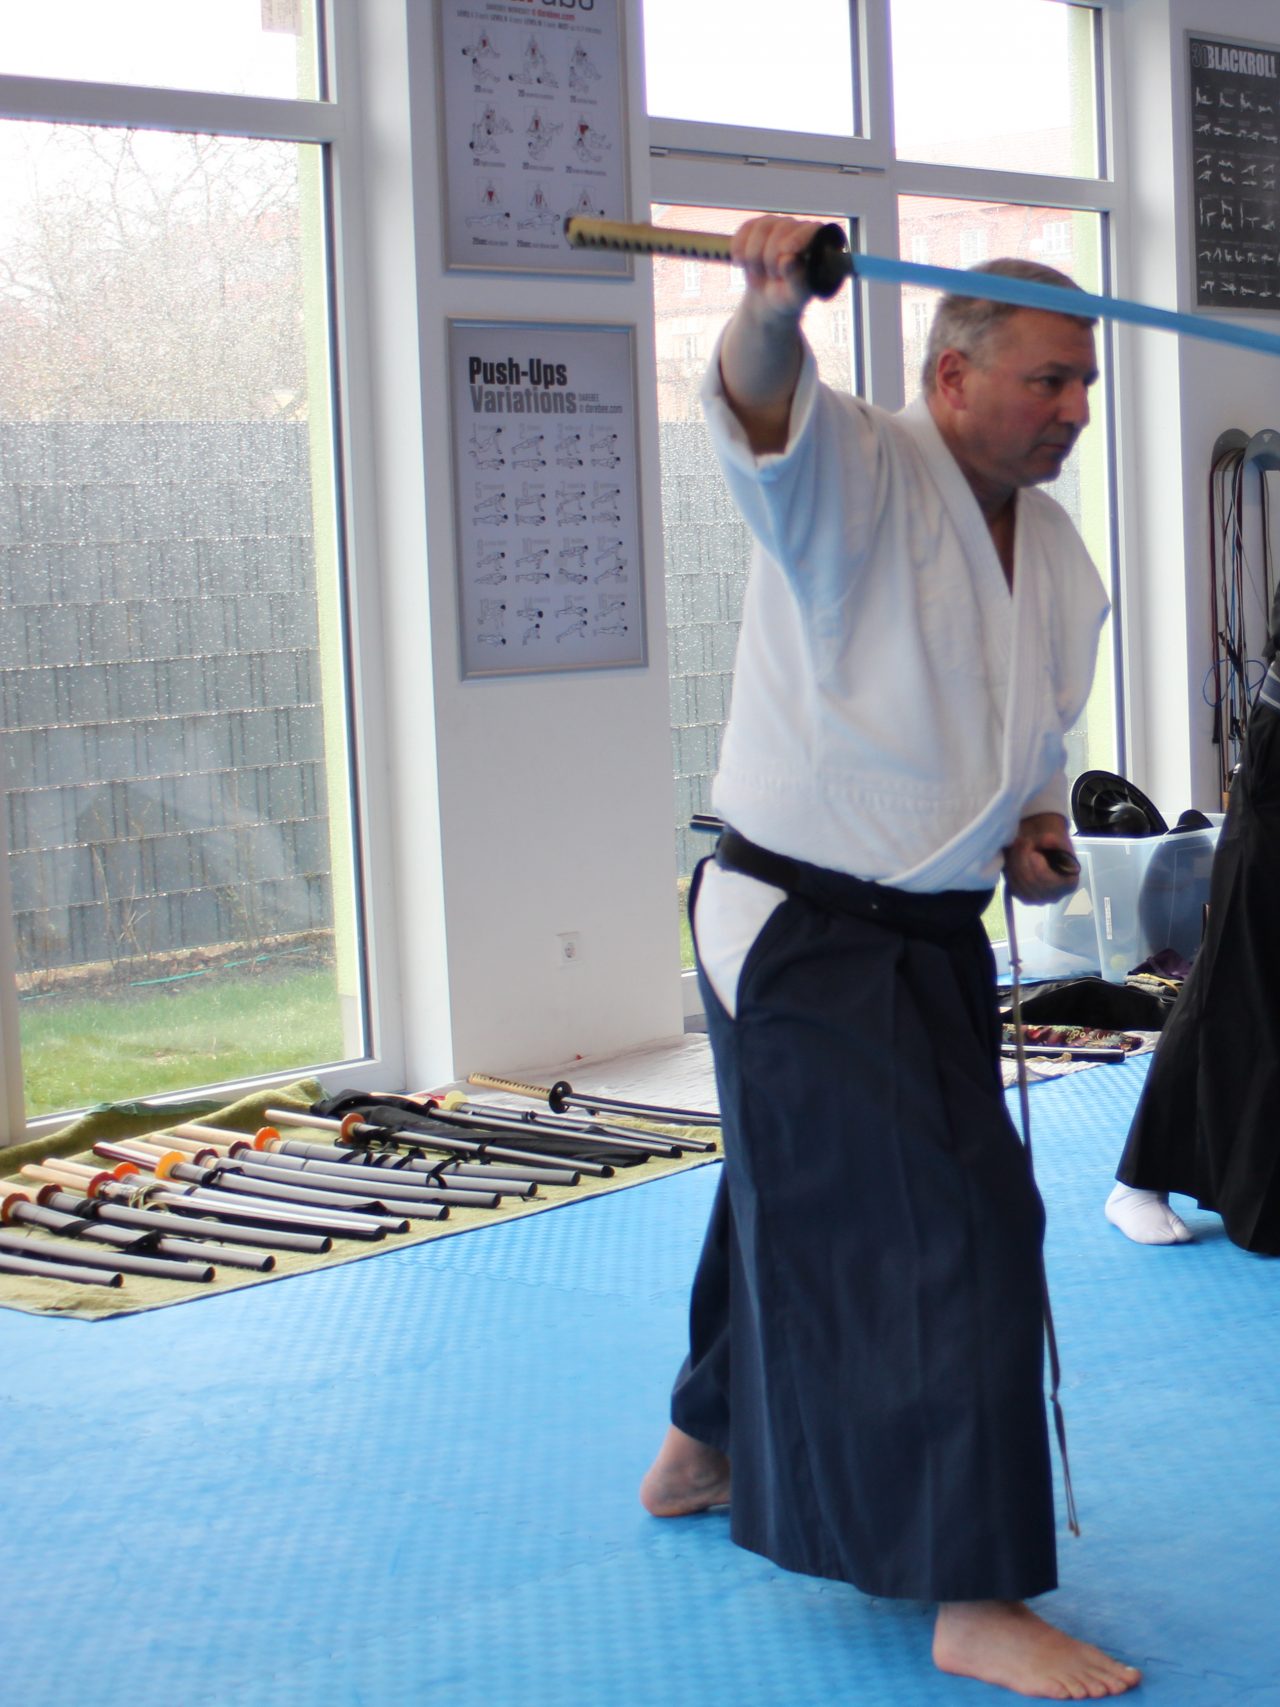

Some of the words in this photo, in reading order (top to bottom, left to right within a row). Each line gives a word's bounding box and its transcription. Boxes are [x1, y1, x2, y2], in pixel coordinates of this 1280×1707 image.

[1207, 46, 1277, 78] BLACKROLL
[469, 356, 568, 389] Push-Ups
[469, 385, 577, 414] Variations
